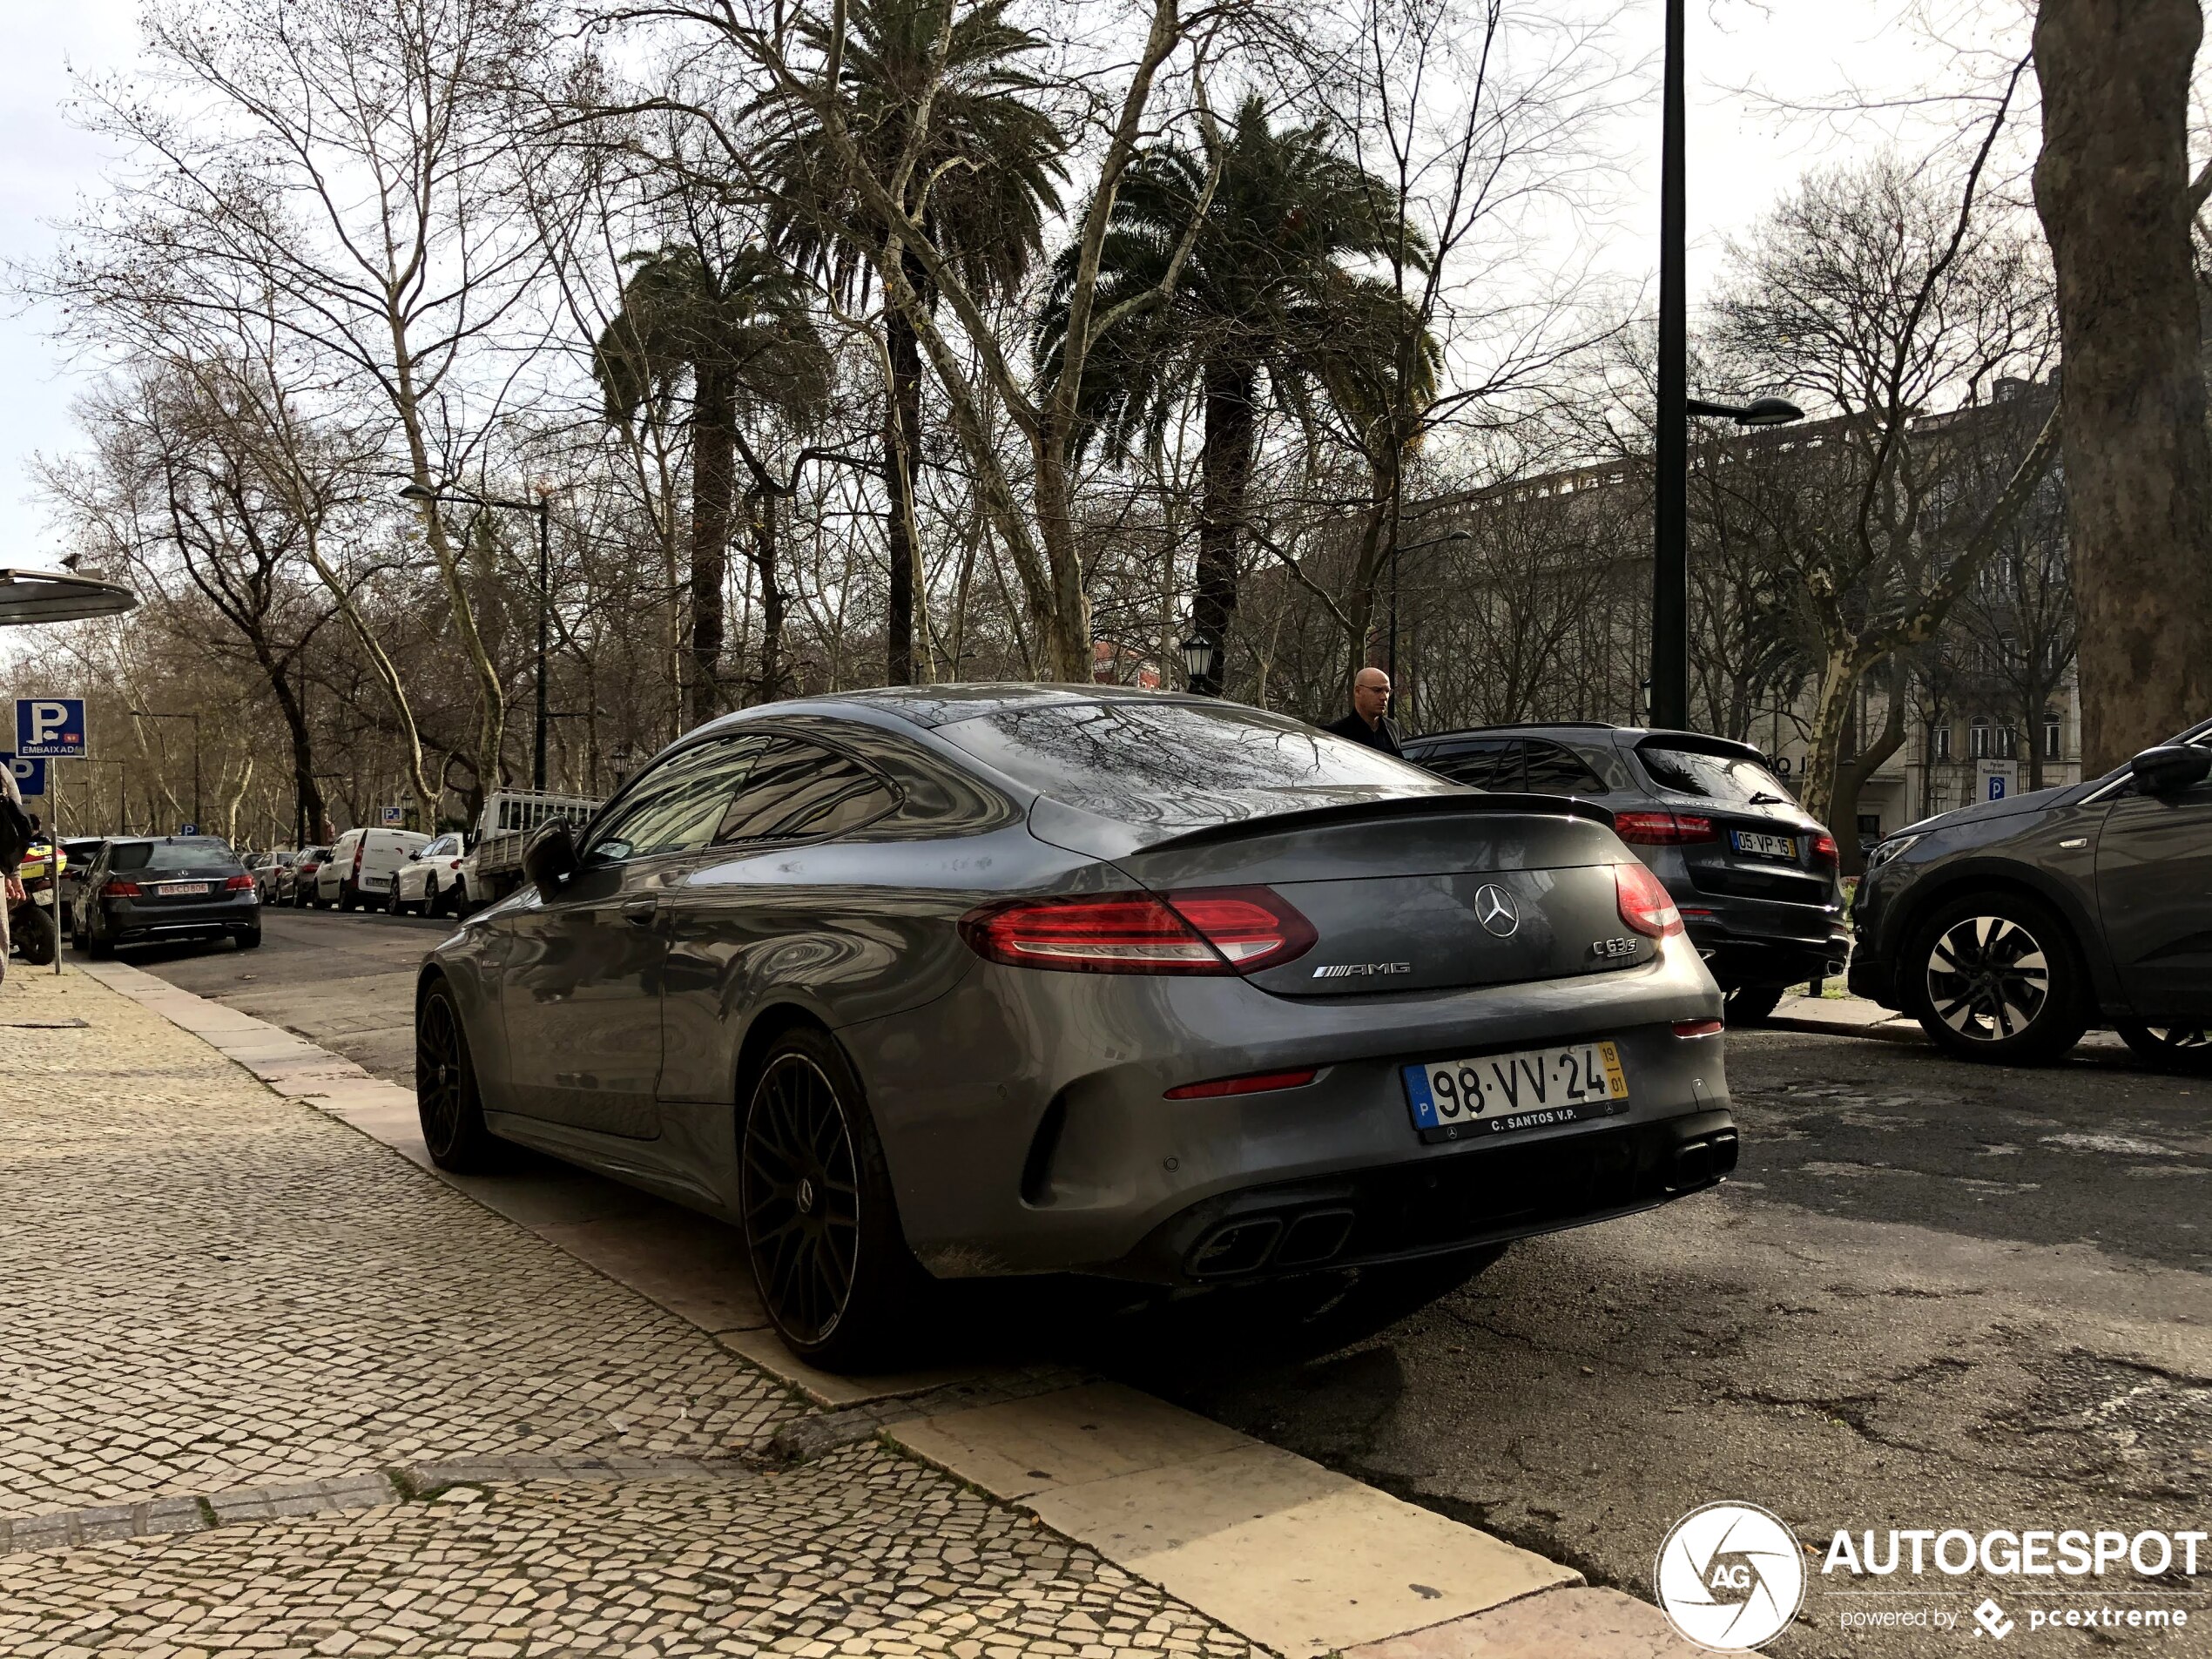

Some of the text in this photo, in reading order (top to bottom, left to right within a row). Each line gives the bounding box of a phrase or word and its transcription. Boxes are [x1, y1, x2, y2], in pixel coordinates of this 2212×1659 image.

[23, 745, 78, 754] EMBAIXAD
[1993, 783, 2001, 799] P
[1593, 941, 1604, 955] C
[1602, 1047, 1615, 1062] 19
[1610, 1076, 1624, 1093] 01
[1420, 1103, 1429, 1116] P
[1491, 1109, 1577, 1132] C. SANTOS V.P.
